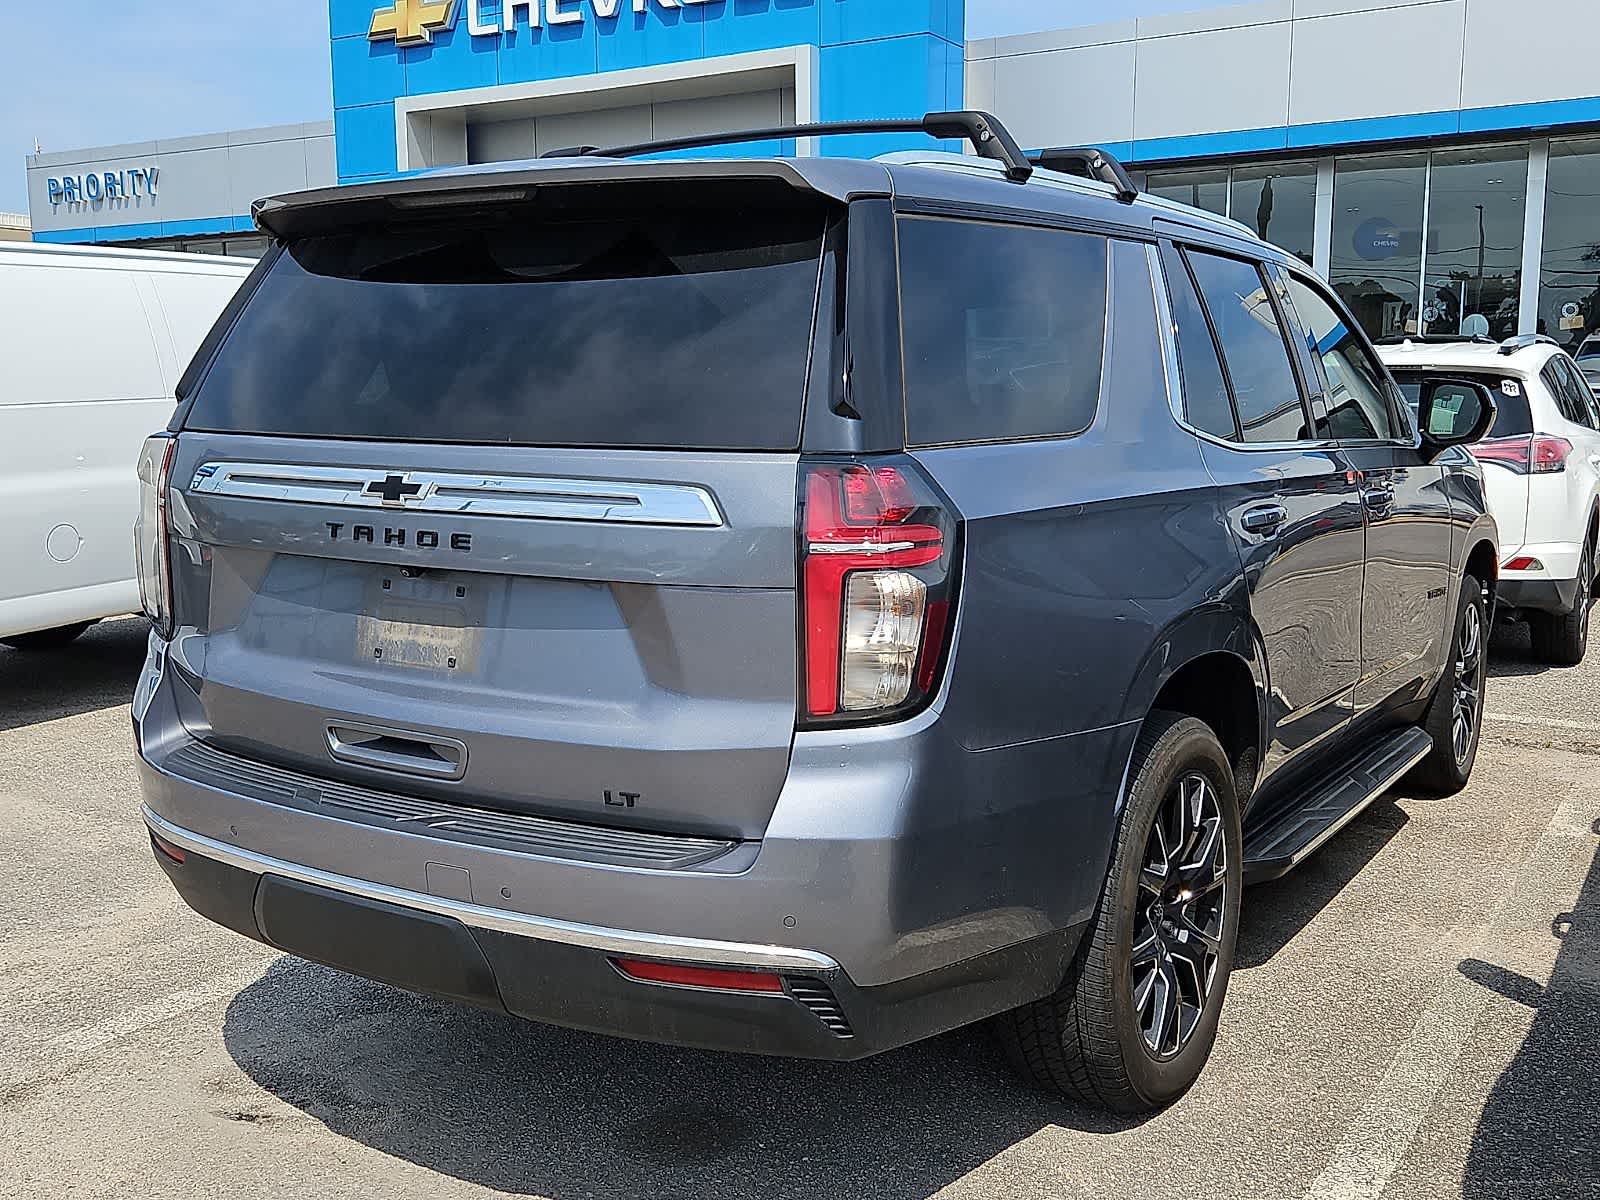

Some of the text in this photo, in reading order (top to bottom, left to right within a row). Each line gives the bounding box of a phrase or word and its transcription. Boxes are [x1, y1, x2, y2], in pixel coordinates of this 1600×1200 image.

[47, 168, 159, 204] PRIORITY
[325, 521, 472, 551] TAHOE
[603, 790, 641, 807] LT
